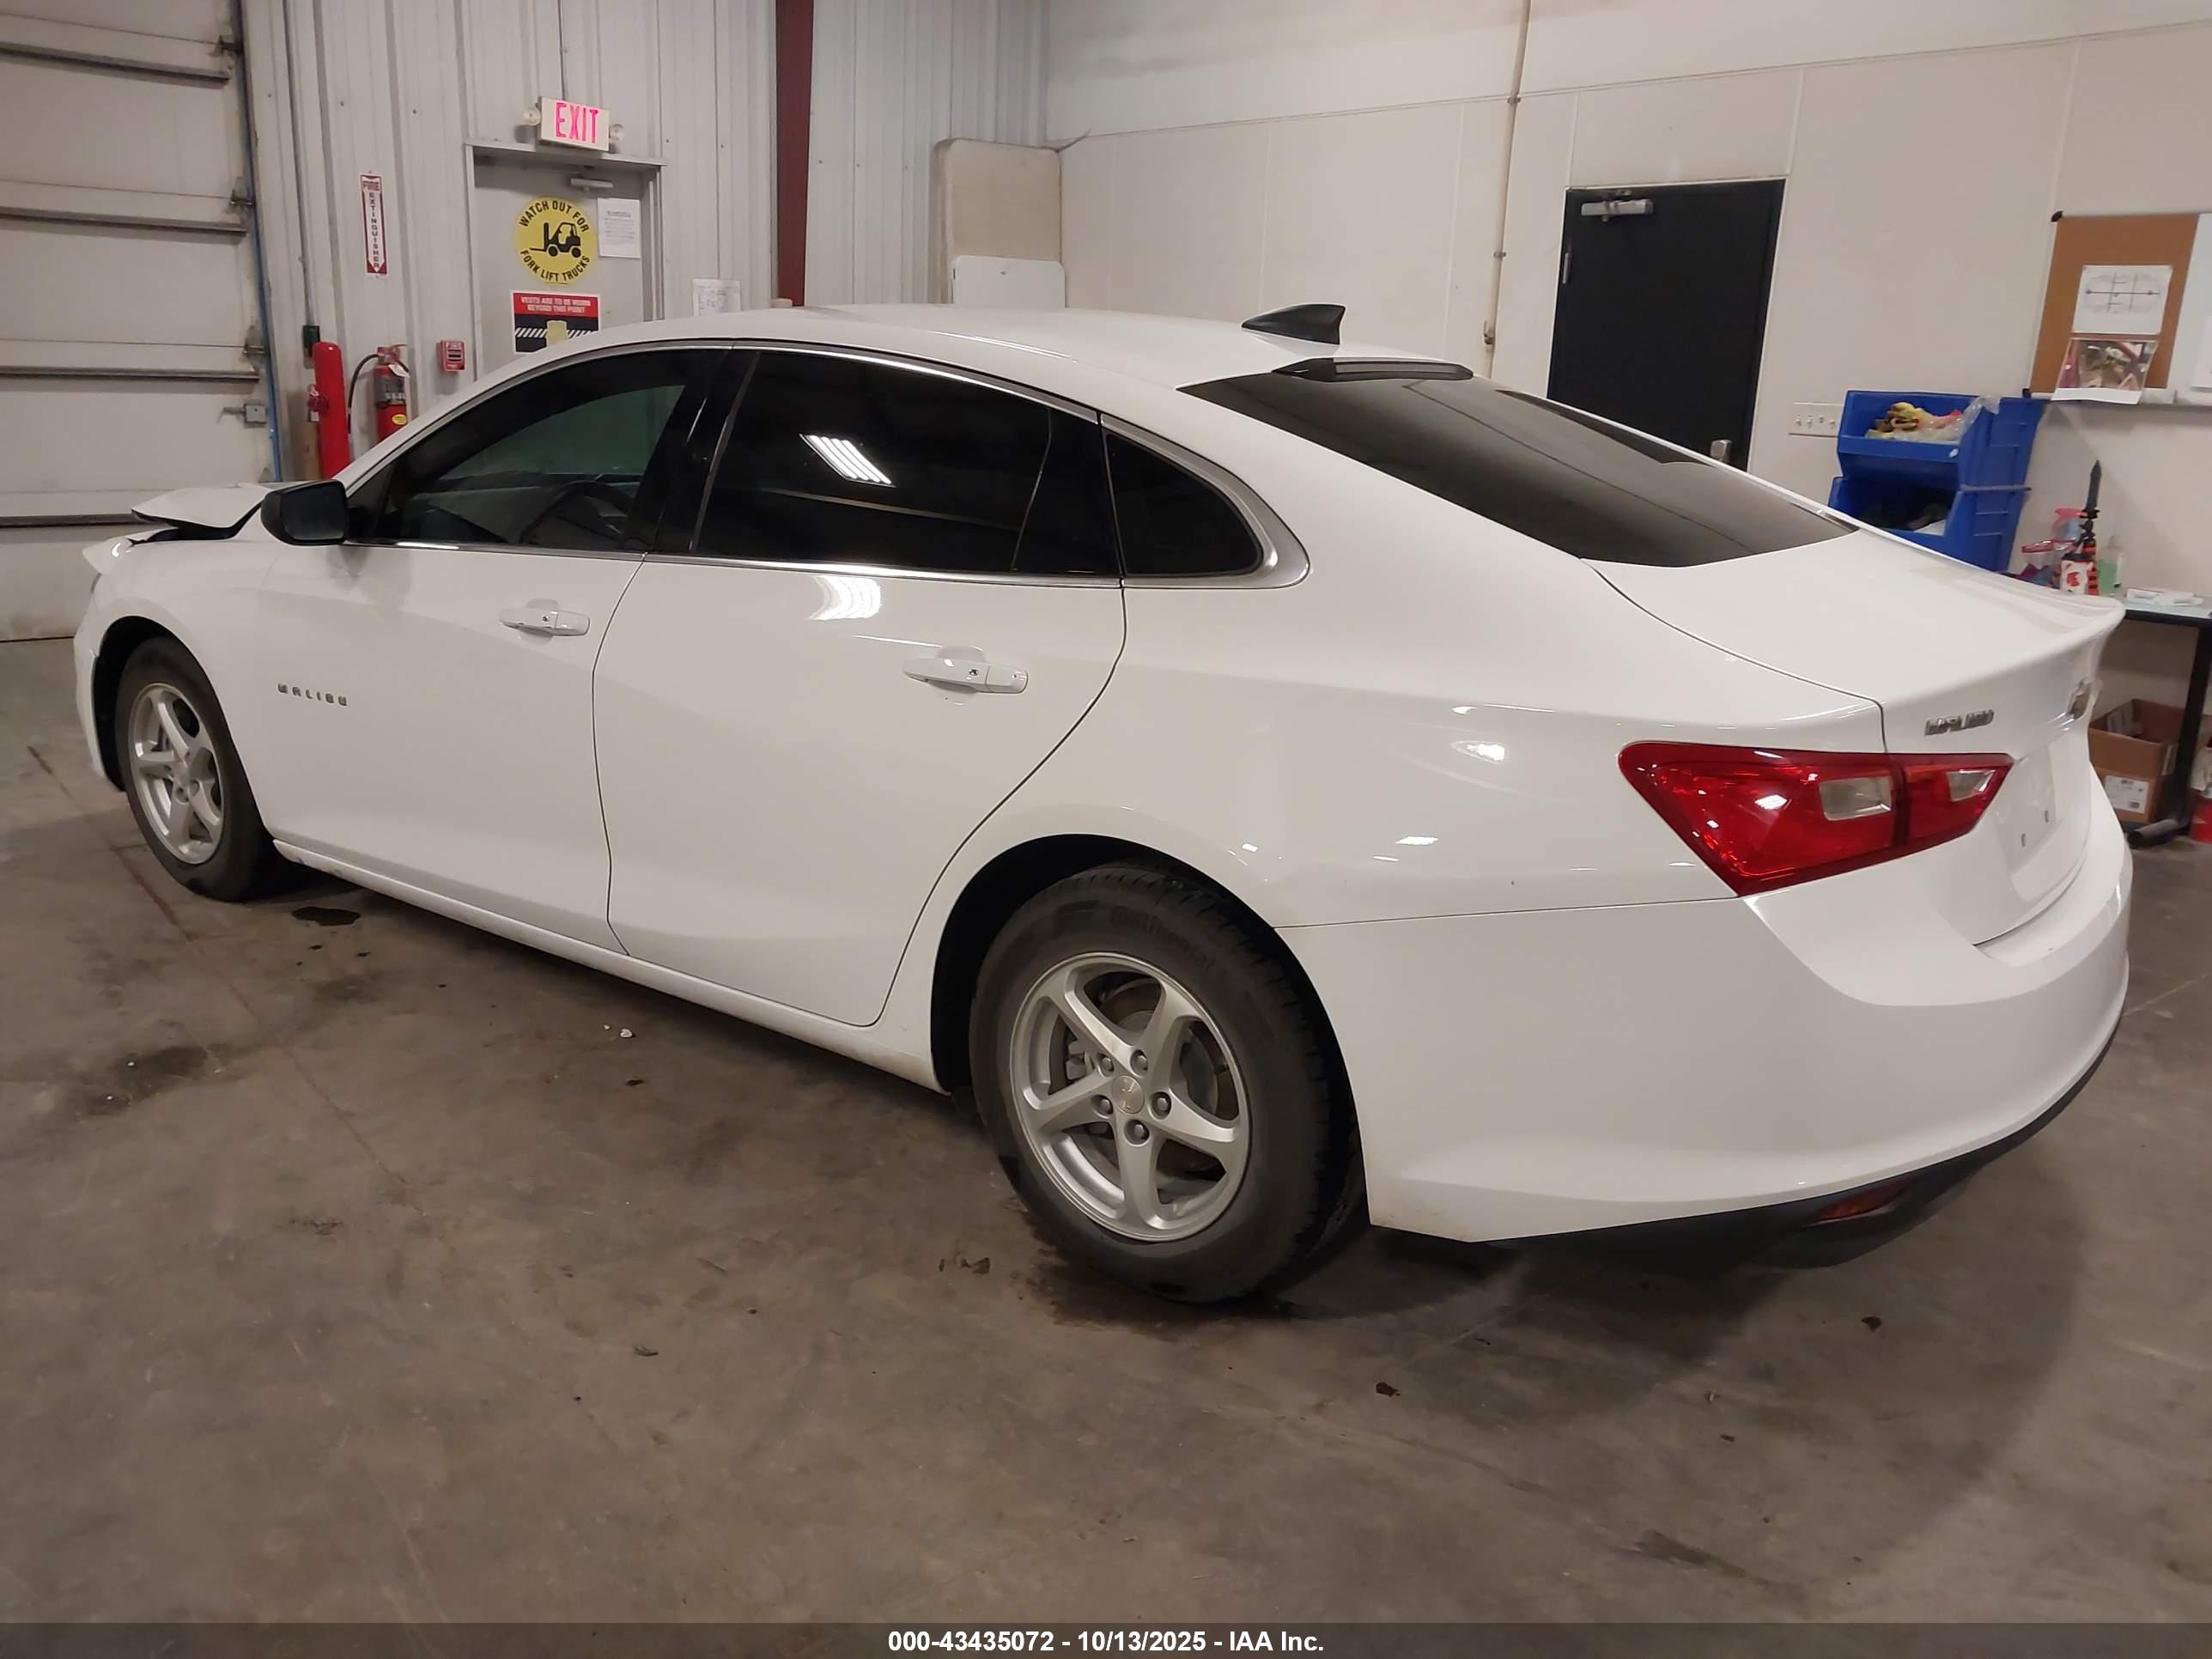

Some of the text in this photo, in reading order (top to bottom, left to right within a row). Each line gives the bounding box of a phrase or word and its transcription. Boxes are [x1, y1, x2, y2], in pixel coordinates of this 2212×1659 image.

[556, 101, 599, 144] EXIT
[362, 180, 380, 191] FIRE
[368, 191, 380, 269] EXTINGUISHER
[519, 200, 550, 228] WATCH
[552, 199, 573, 214] OUT
[572, 211, 590, 233] FOR
[520, 250, 590, 282] FORK LIFT TRUCKS
[276, 683, 348, 706] MALIBU
